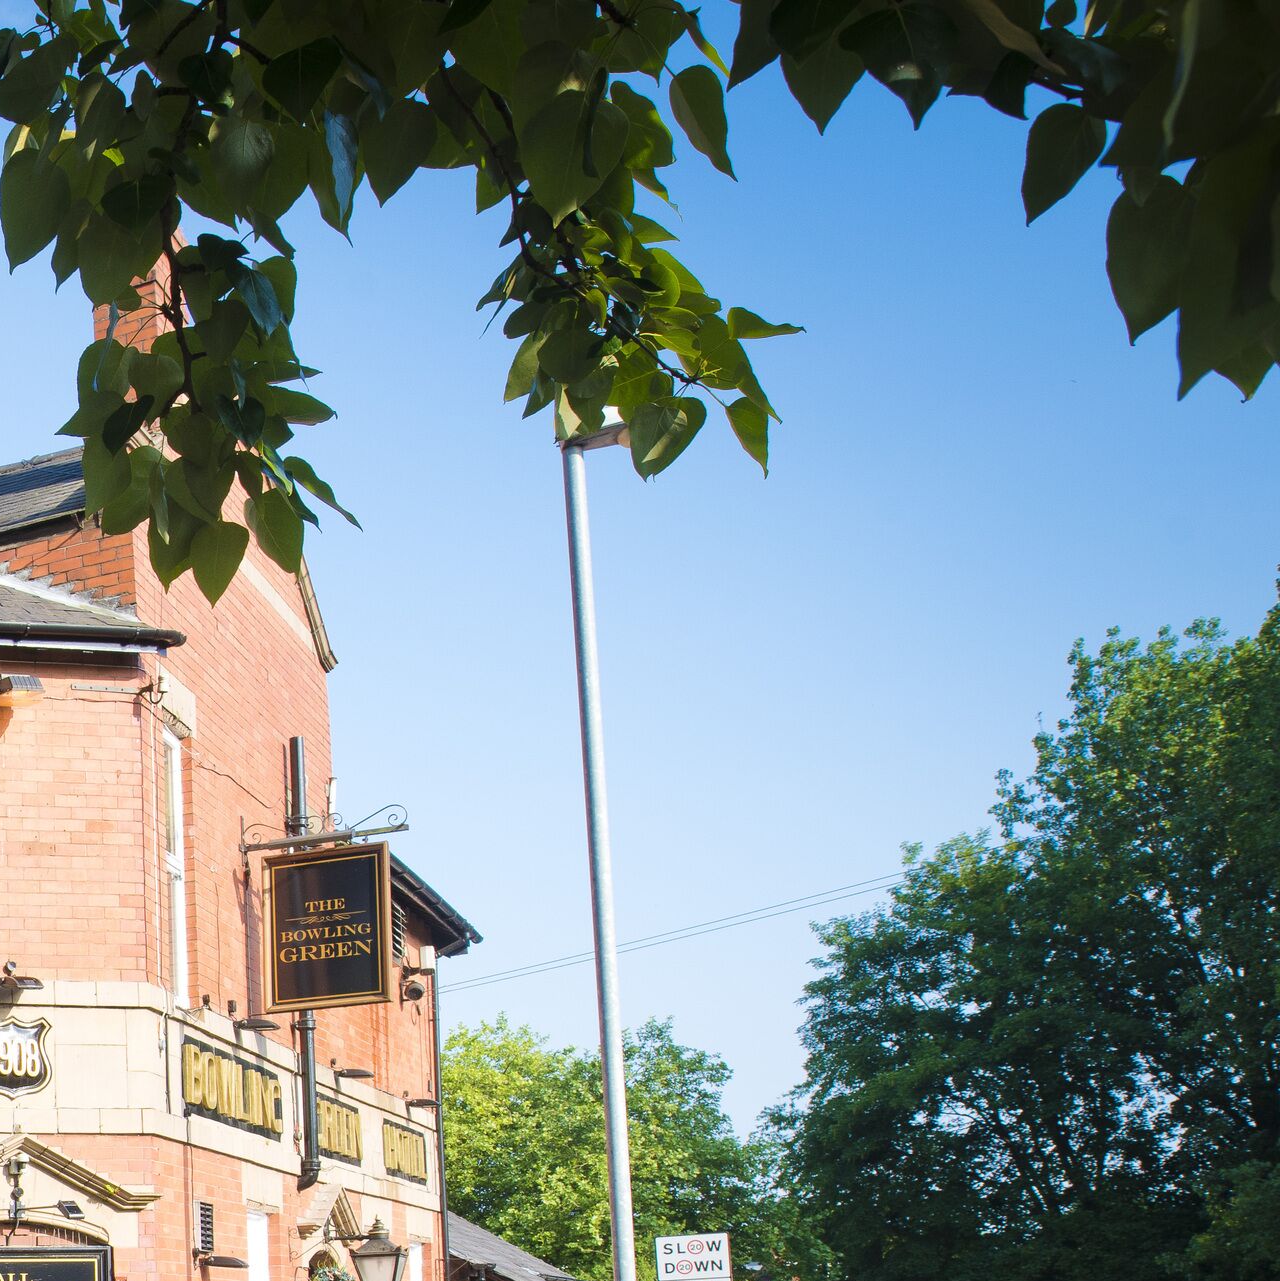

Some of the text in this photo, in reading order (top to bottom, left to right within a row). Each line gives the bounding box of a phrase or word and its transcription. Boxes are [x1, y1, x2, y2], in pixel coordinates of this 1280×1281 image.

[305, 898, 345, 913] THE
[280, 922, 371, 943] BOWLING
[280, 940, 373, 963] GREEN
[183, 1044, 283, 1134] BOWLING
